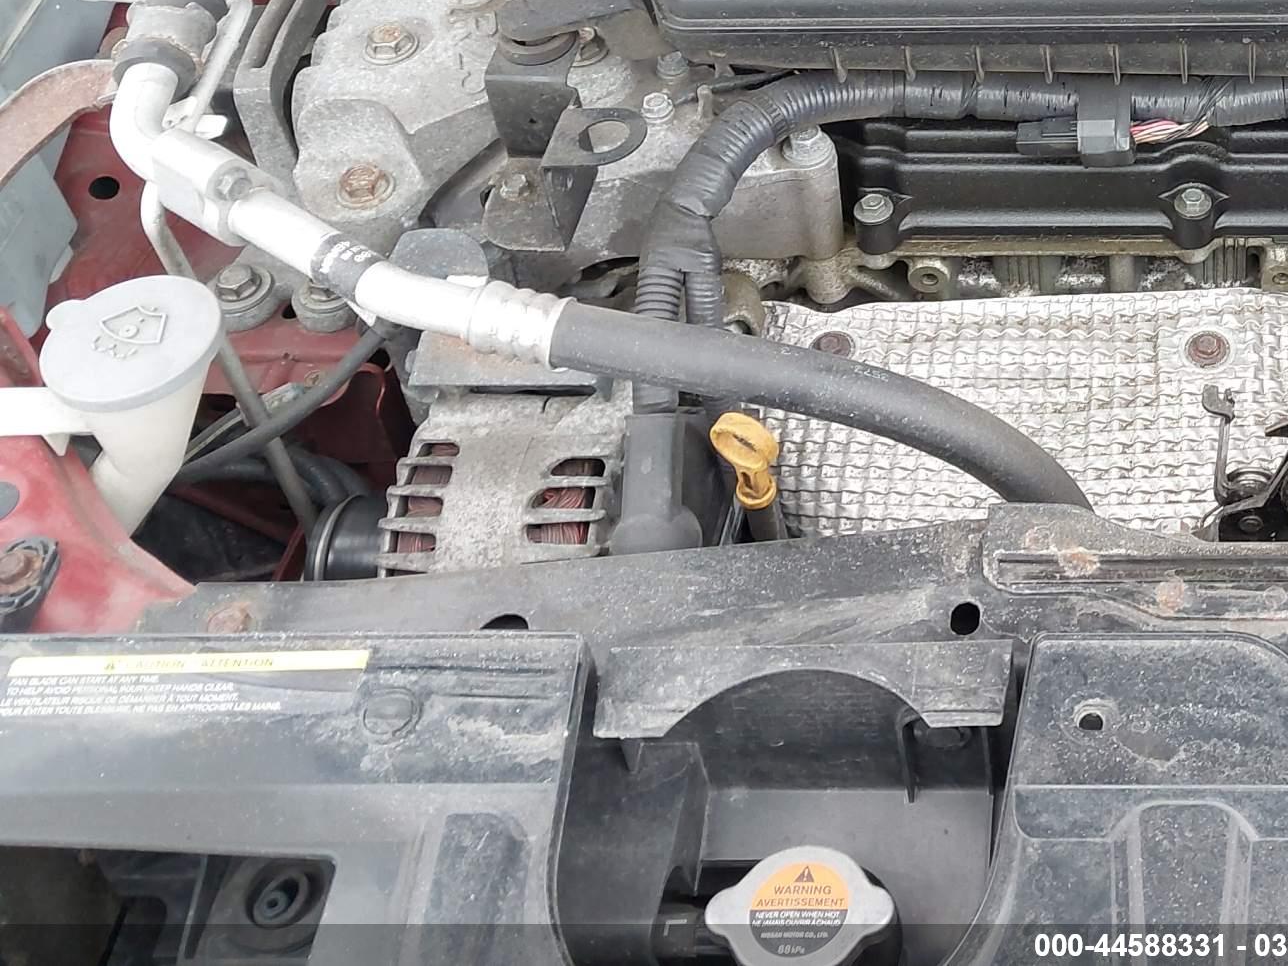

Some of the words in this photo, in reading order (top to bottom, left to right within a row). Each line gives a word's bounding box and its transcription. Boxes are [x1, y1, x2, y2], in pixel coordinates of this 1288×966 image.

[200, 657, 273, 668] ATTENTION
[774, 885, 832, 895] WARNING
[757, 897, 845, 907] AVERTISSEMENT
[755, 911, 779, 919] NEVER
[780, 911, 801, 919] OPEN
[800, 911, 825, 919] WHEN
